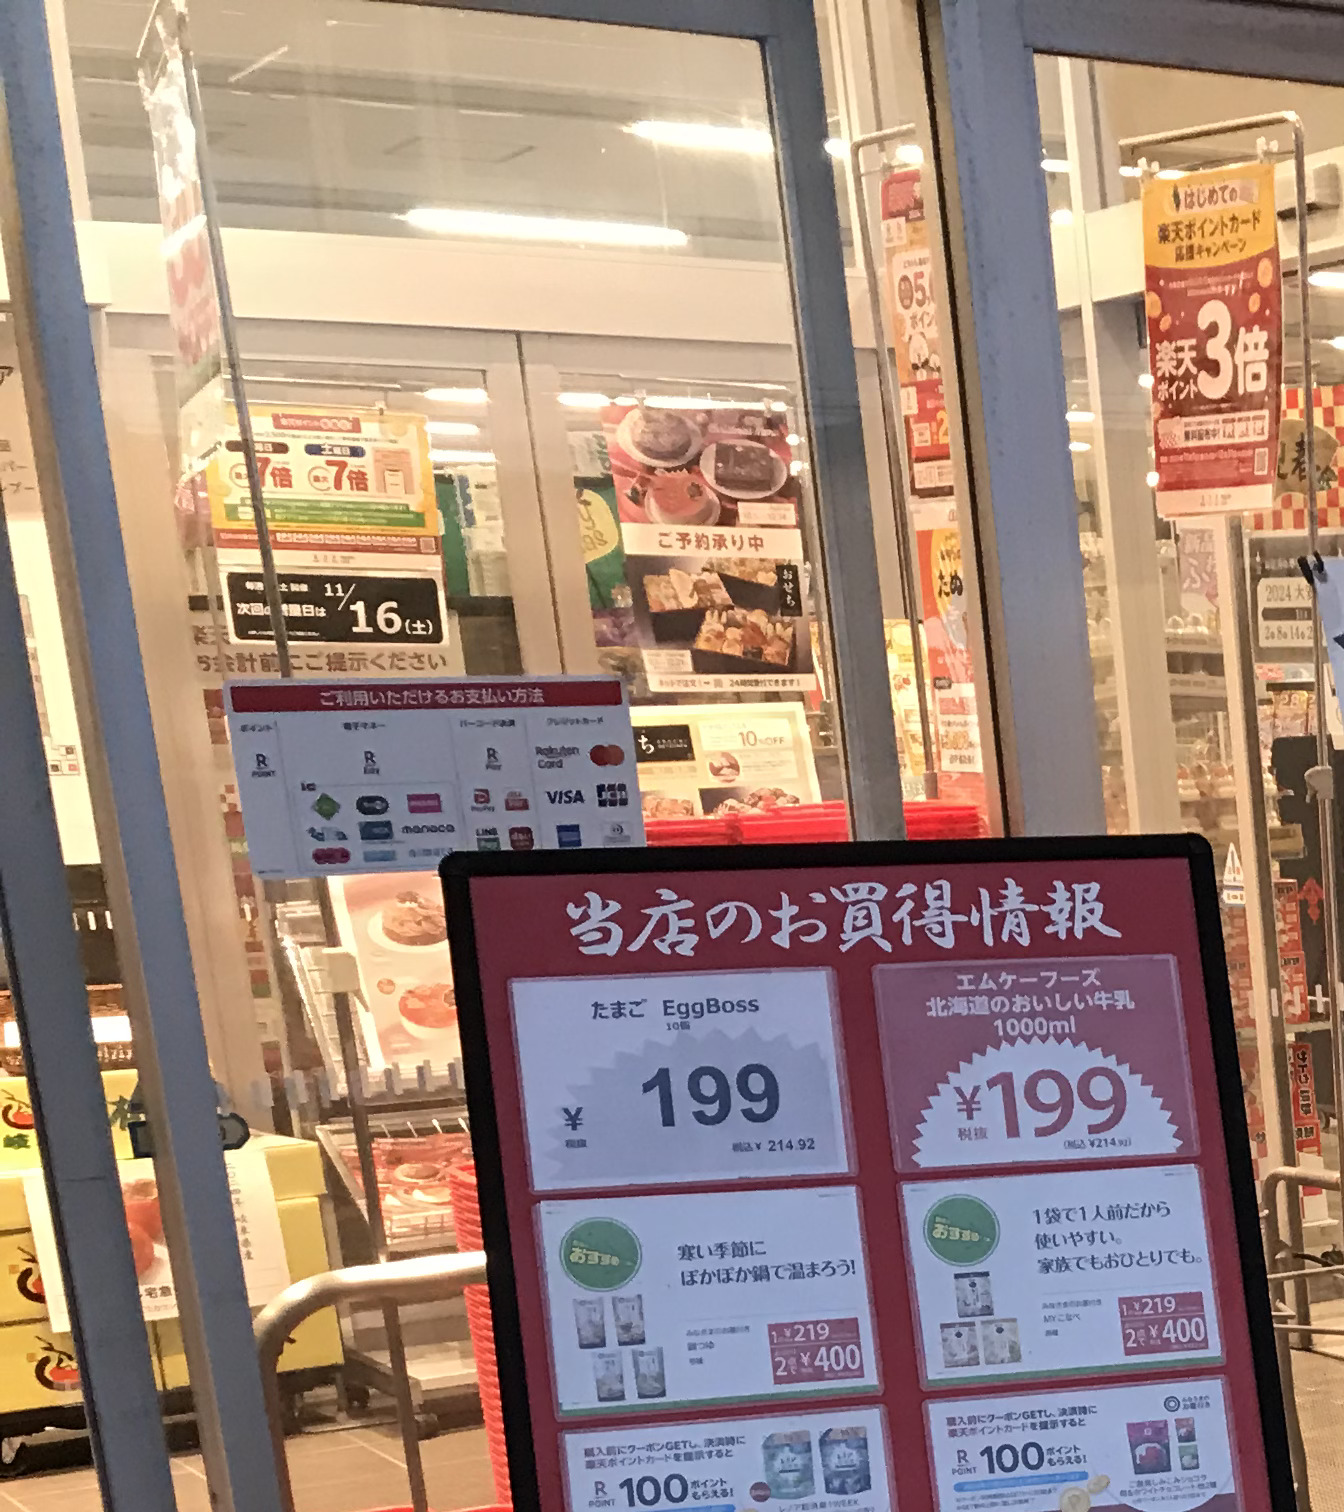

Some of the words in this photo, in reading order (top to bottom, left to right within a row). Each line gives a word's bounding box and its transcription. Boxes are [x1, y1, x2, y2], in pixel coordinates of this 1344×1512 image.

[1184, 185, 1238, 210] はじめての
[1155, 338, 1197, 377] 楽天
[1197, 300, 1269, 399] 3倍
[1157, 378, 1198, 401] ポイント
[325, 459, 369, 492] 7倍
[658, 531, 765, 551] ご予約承り中
[319, 688, 545, 707] ご利用いただけるお支払い方法
[545, 790, 586, 804] VISA
[564, 879, 1122, 958] 当店のお買得情報
[956, 968, 1102, 991] エムケーフーズ
[591, 999, 648, 1019] たまご
[662, 997, 760, 1020] EggBoss
[926, 989, 1136, 1017] 北海道のおいしい牛乳
[993, 1016, 1076, 1036] 1000ml
[642, 1063, 780, 1128] 199
[768, 1138, 816, 1152] 214.92
[1031, 1202, 1171, 1225] 1袋で1人前だから
[677, 1240, 767, 1262] 寒い季節に
[1034, 1230, 1123, 1251] 使いやすい。
[1037, 1249, 1203, 1275] 家族でもおひとりでも。
[956, 1449, 970, 1465] R
[979, 1441, 1045, 1475] 100
[1045, 1444, 1081, 1457] ポイント
[1046, 1454, 1088, 1467] もらえる!
[951, 1465, 977, 1475] POINT
[594, 1481, 607, 1496] R
[619, 1473, 689, 1507] 100
[691, 1478, 727, 1489] ポイント
[691, 1488, 734, 1500] もらえる!
[589, 1499, 615, 1508] POINT
